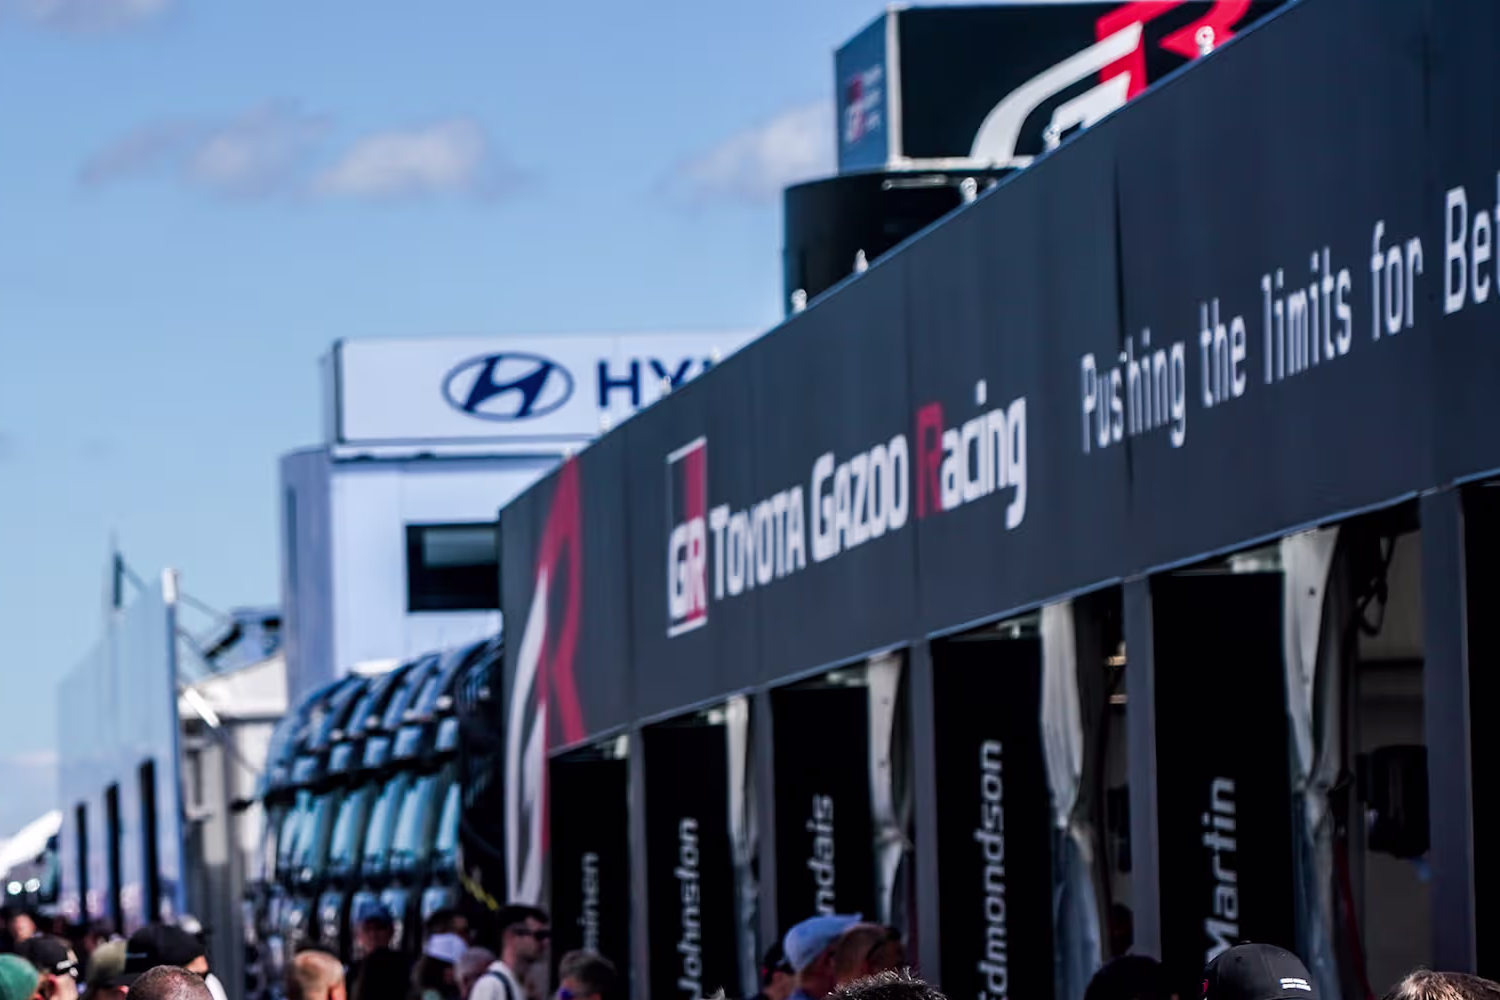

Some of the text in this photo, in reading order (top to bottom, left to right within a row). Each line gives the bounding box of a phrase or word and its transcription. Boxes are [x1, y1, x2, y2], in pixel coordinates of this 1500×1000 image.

[1081, 327, 1186, 454] Pushing
[1200, 298, 1246, 408] the
[1261, 246, 1352, 384] limits
[1370, 219, 1424, 340] for
[710, 484, 806, 600] TOYOTA
[811, 433, 910, 563] GAZOO
[915, 379, 1027, 530] Racing
[1203, 776, 1239, 963] Martin
